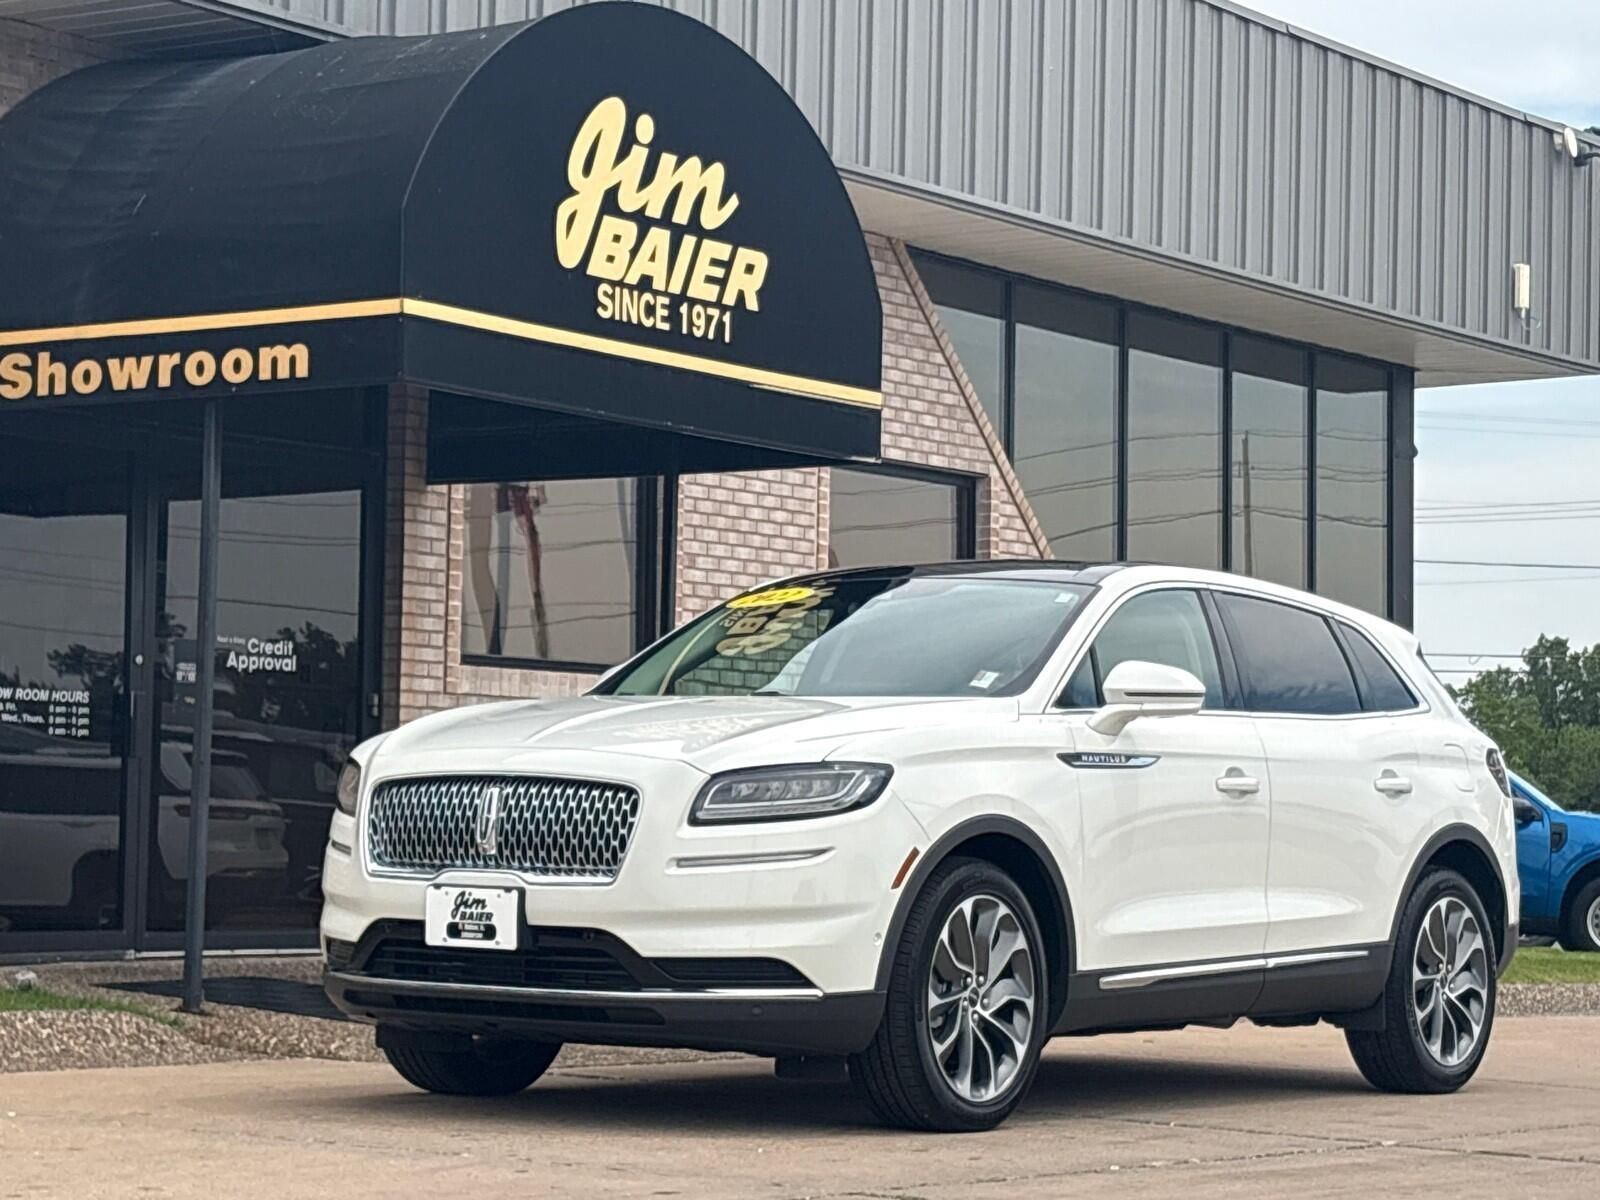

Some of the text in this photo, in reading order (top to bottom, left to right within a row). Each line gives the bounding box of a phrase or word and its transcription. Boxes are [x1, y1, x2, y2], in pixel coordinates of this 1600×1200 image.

[556, 96, 740, 269] Jim
[586, 214, 769, 312] BAIER
[596, 283, 732, 344] SINCE 1971
[0, 343, 309, 400] Showroom
[247, 638, 294, 656] Credit
[226, 651, 297, 673] Approval
[15, 688, 50, 702] ROOM
[51, 690, 90, 704] HOURS
[1081, 754, 1126, 763] NAUTILUS
[451, 890, 488, 920] Jim
[459, 911, 494, 922] BAIER
